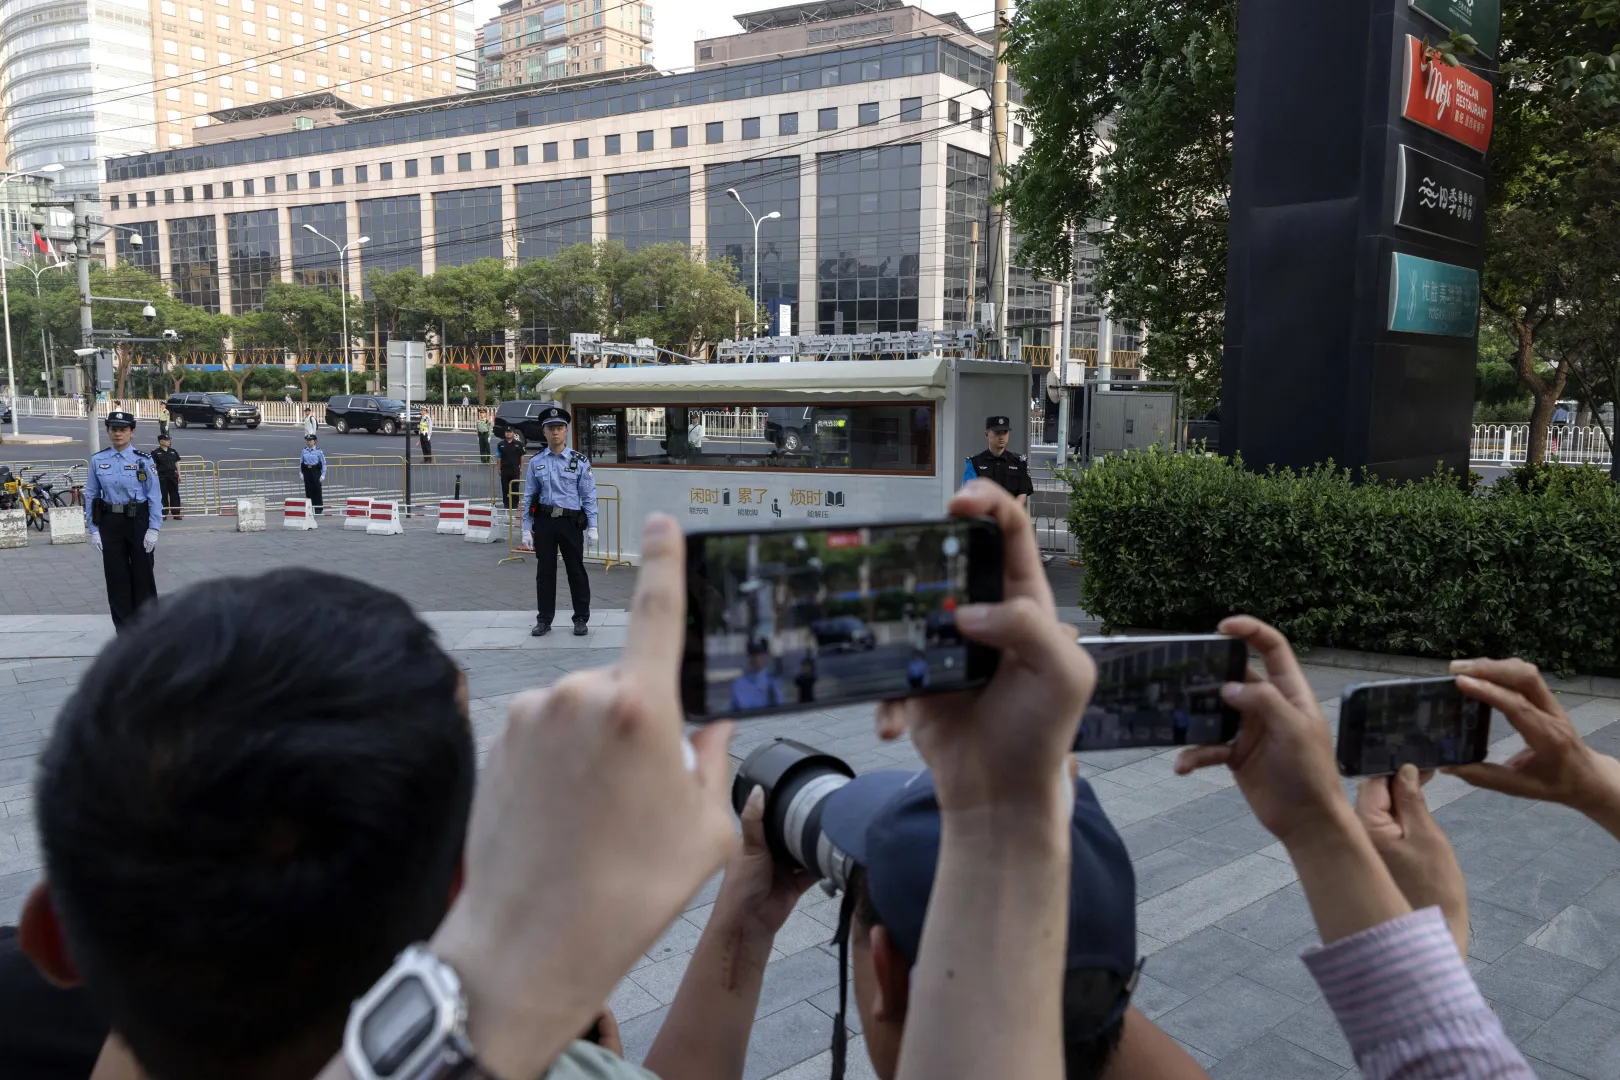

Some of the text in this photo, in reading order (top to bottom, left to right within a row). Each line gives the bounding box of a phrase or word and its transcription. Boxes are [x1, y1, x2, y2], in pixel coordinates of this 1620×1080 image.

[1456, 78, 1479, 100] MEXICAN
[1455, 93, 1487, 120] RESTAURANT
[690, 487, 720, 504] 闲时
[738, 487, 768, 504] 累了
[790, 488, 823, 506] 烦时
[689, 507, 709, 515] 能充电
[807, 510, 829, 518] 能解压
